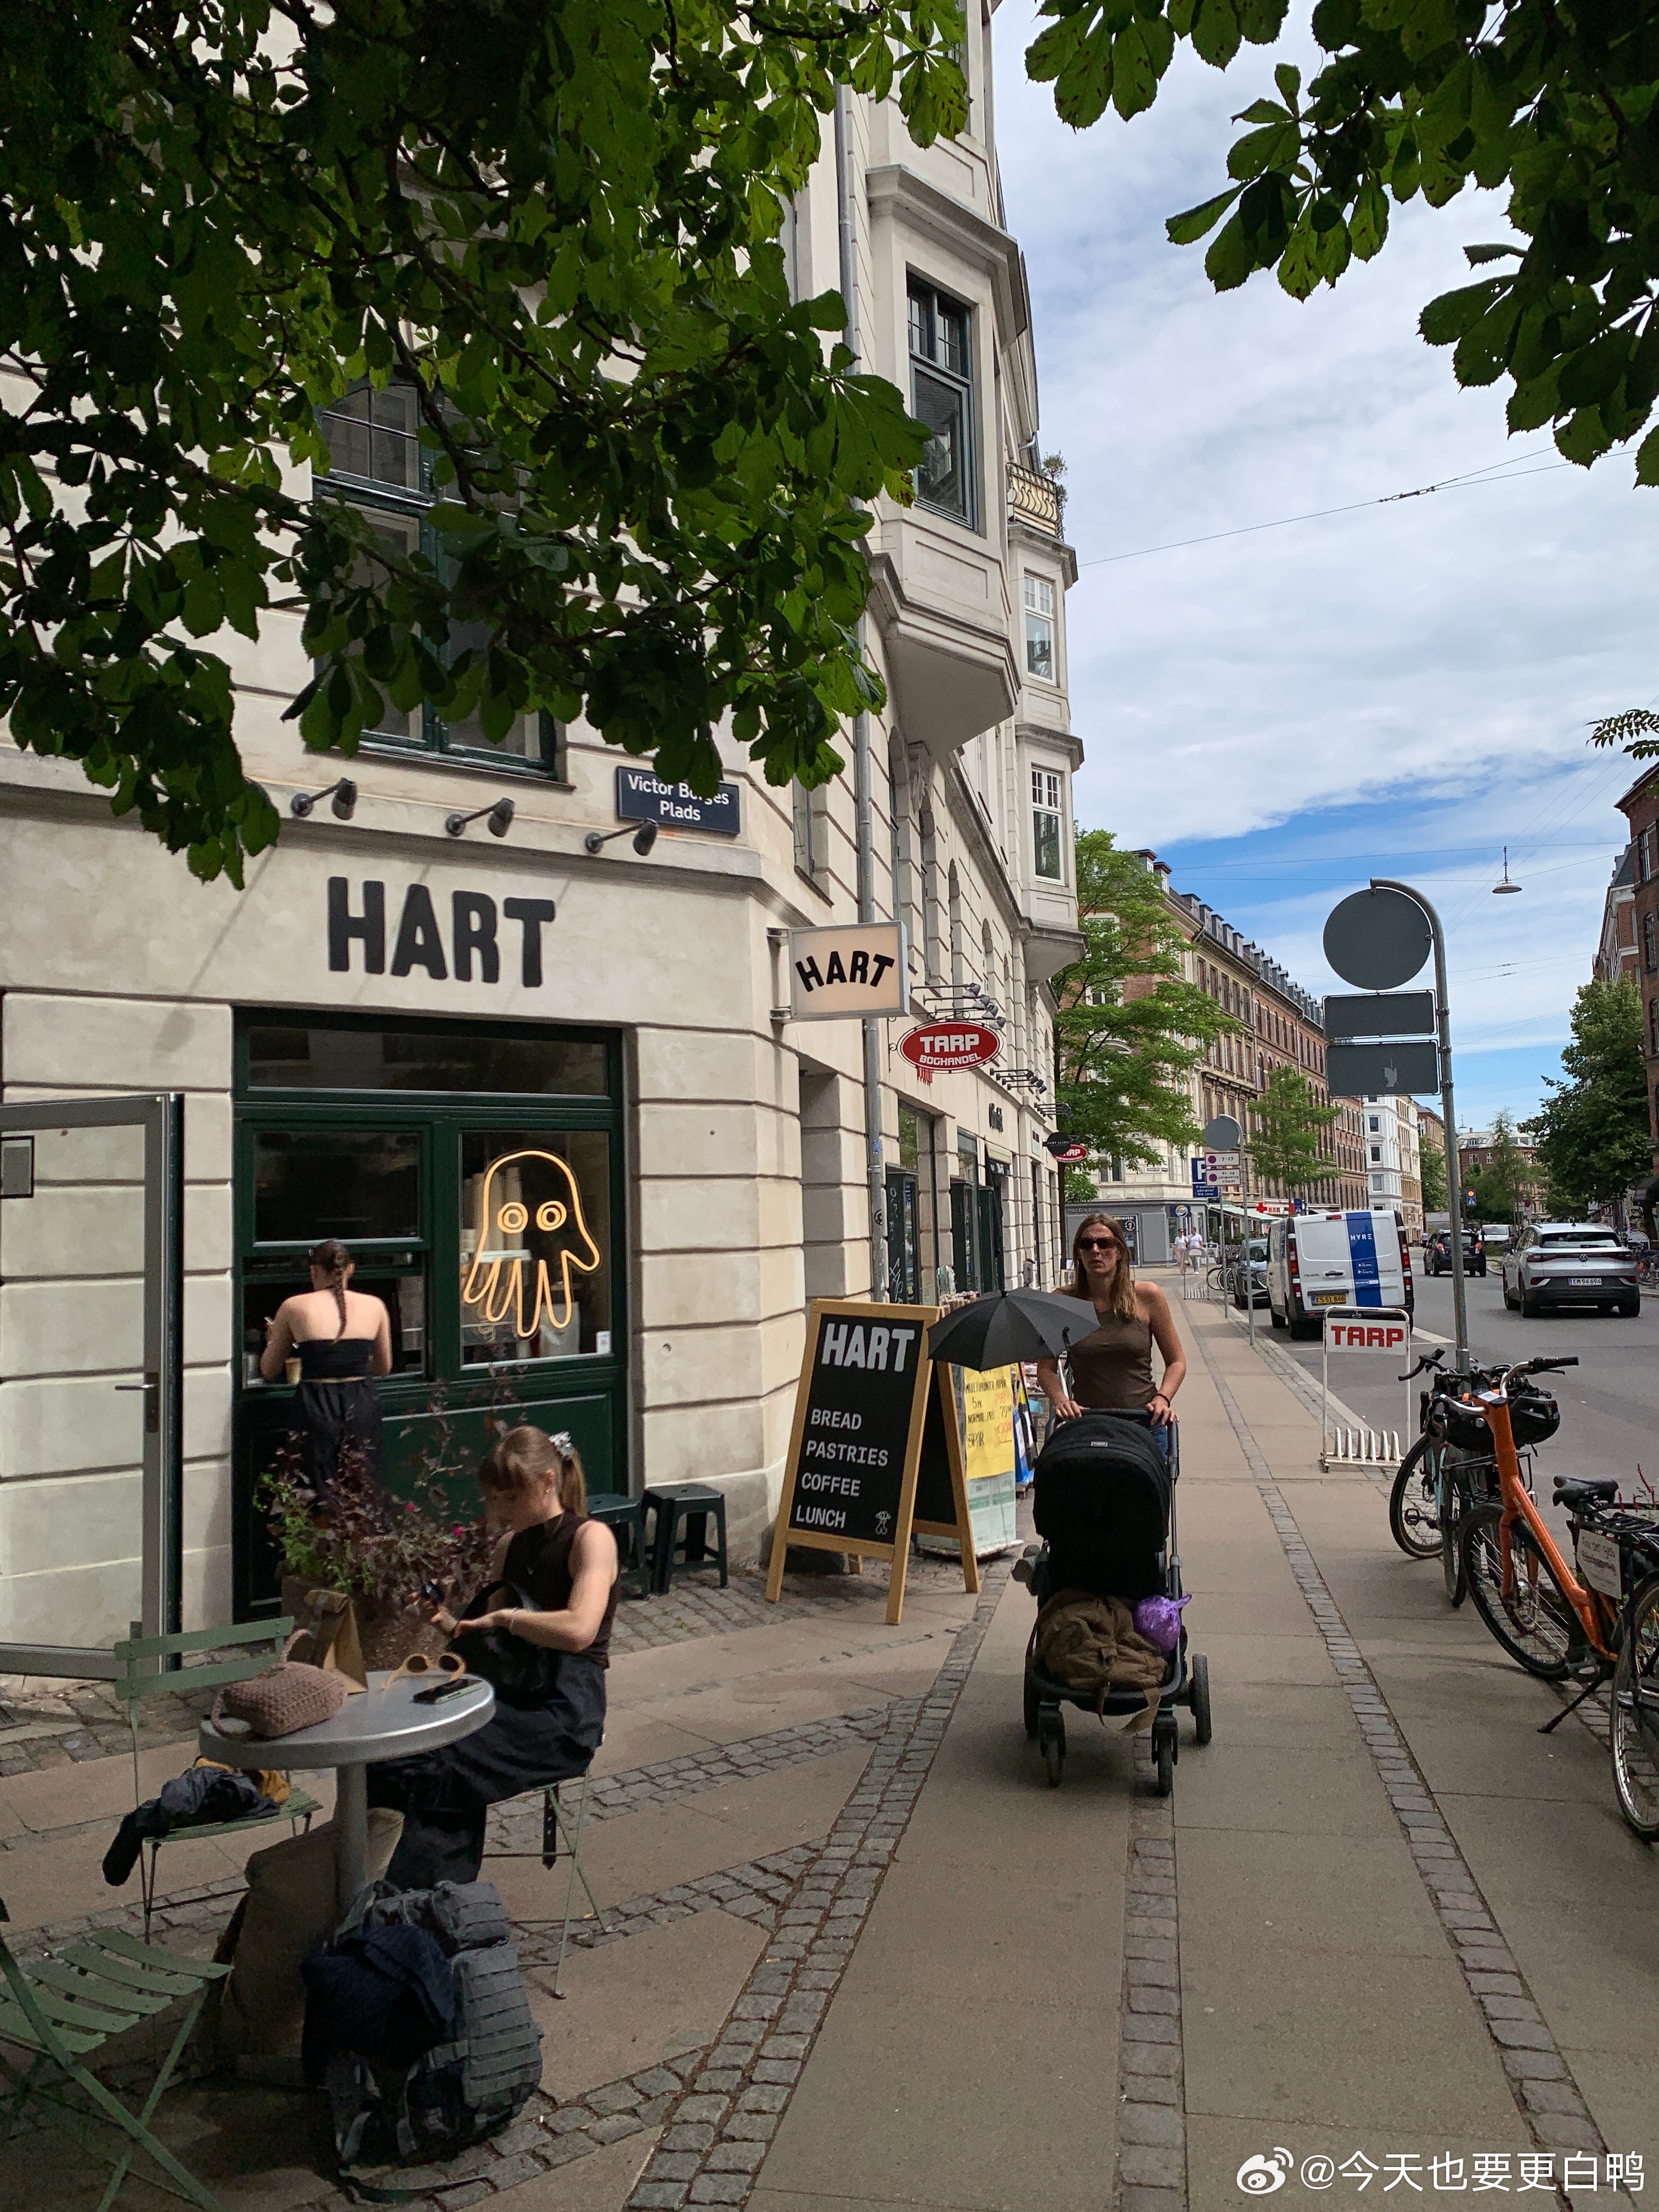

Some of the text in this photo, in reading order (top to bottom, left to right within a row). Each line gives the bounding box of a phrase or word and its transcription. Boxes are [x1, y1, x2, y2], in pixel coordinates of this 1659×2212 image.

[628, 774, 674, 795] Victor
[659, 800, 701, 821] Plads
[328, 876, 555, 988] HART
[795, 950, 895, 992] HART
[919, 1034, 979, 1053] TARP
[919, 1053, 982, 1066] BOGHANDEL
[822, 1323, 915, 1372] HART
[1330, 1325, 1404, 1347] TARP
[810, 1408, 862, 1431] BREAD
[968, 1413, 984, 1424] NORMAL
[805, 1440, 889, 1467] PASTRIES
[801, 1471, 861, 1497] COFFEE
[795, 1506, 846, 1529] LUNCH
